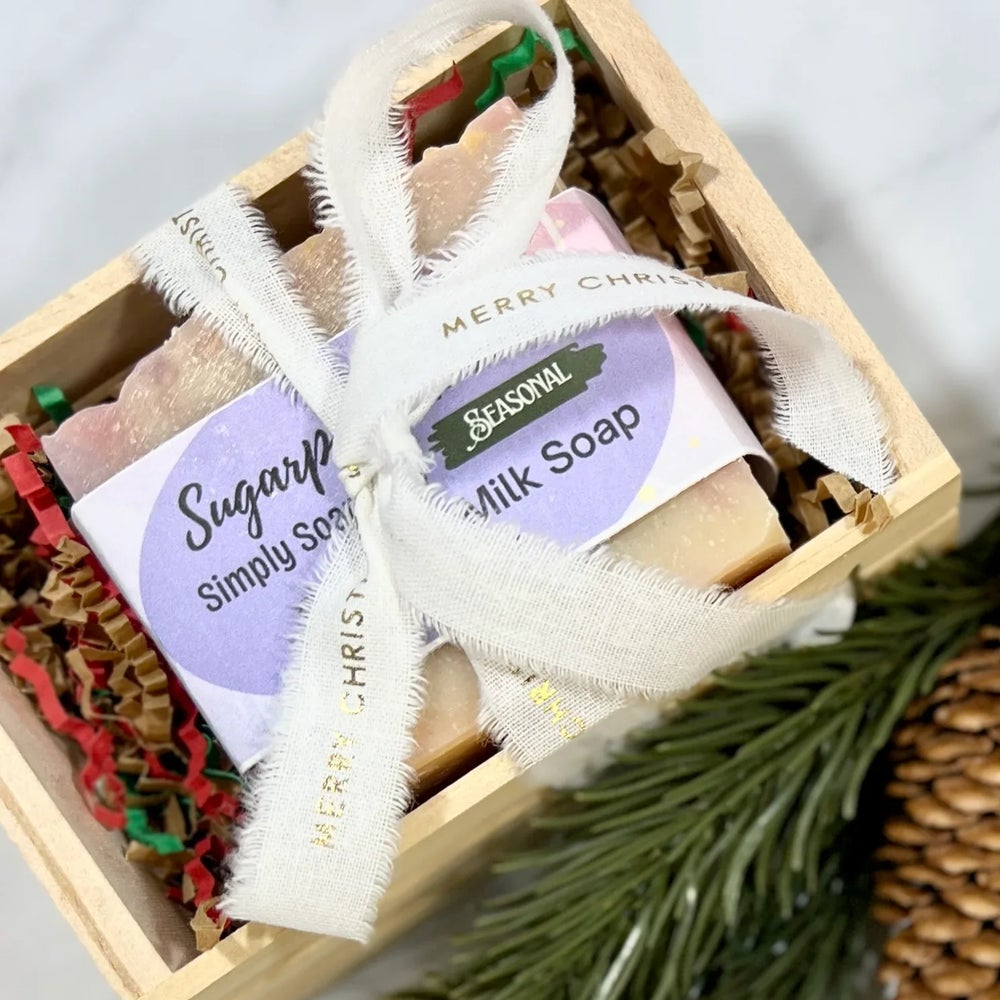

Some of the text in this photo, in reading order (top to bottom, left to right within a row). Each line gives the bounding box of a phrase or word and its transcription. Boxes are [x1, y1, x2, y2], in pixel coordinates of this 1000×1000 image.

[441, 272, 722, 339] MERRY CHRIST
[462, 361, 573, 452] SEASONAL
[540, 404, 640, 475] Soap
[197, 539, 298, 613] Simply
[310, 577, 367, 849] MERRY CHRIST
